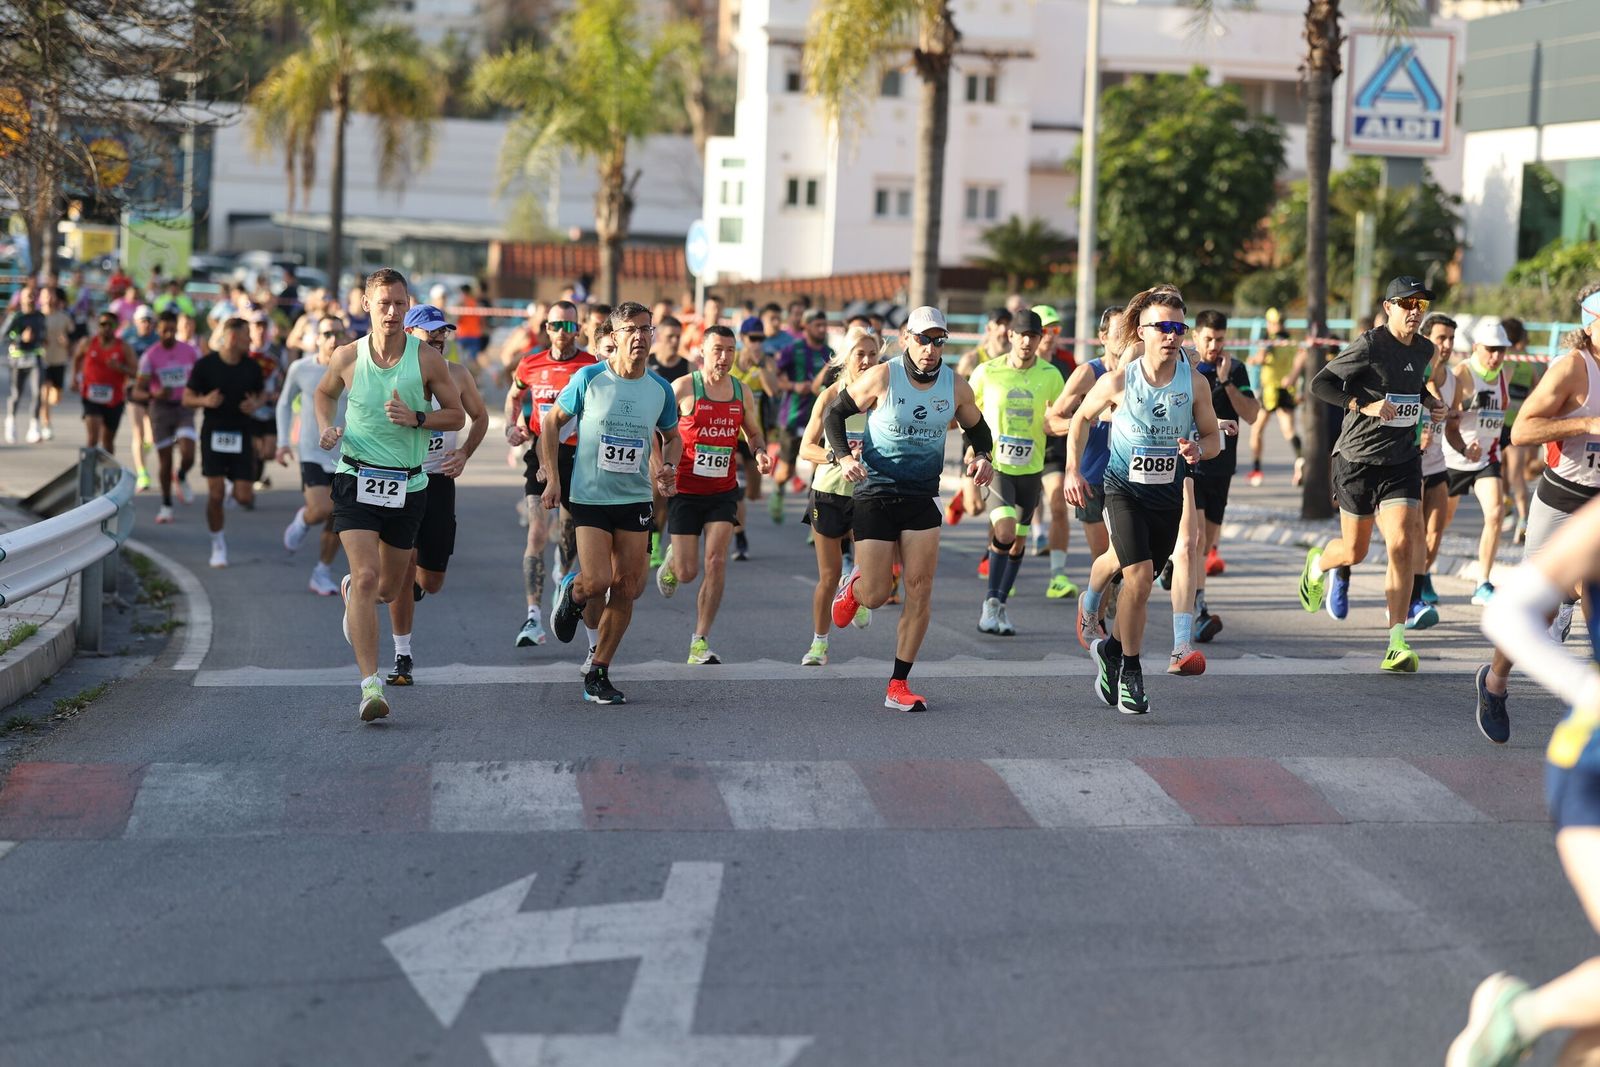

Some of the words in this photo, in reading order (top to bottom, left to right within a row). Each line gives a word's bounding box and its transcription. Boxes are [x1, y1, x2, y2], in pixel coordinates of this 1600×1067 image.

[1357, 117, 1434, 139] ALDI
[1396, 403, 1419, 417] 486
[709, 417, 713, 425] I
[714, 417, 727, 425] did
[728, 417, 734, 426] it
[428, 437, 444, 451] 22
[999, 445, 1032, 458] 1797
[604, 446, 636, 462] 314
[697, 454, 729, 468] 2168
[1586, 452, 1600, 469] 1
[1132, 456, 1175, 472] 2088
[365, 478, 399, 496] 212
